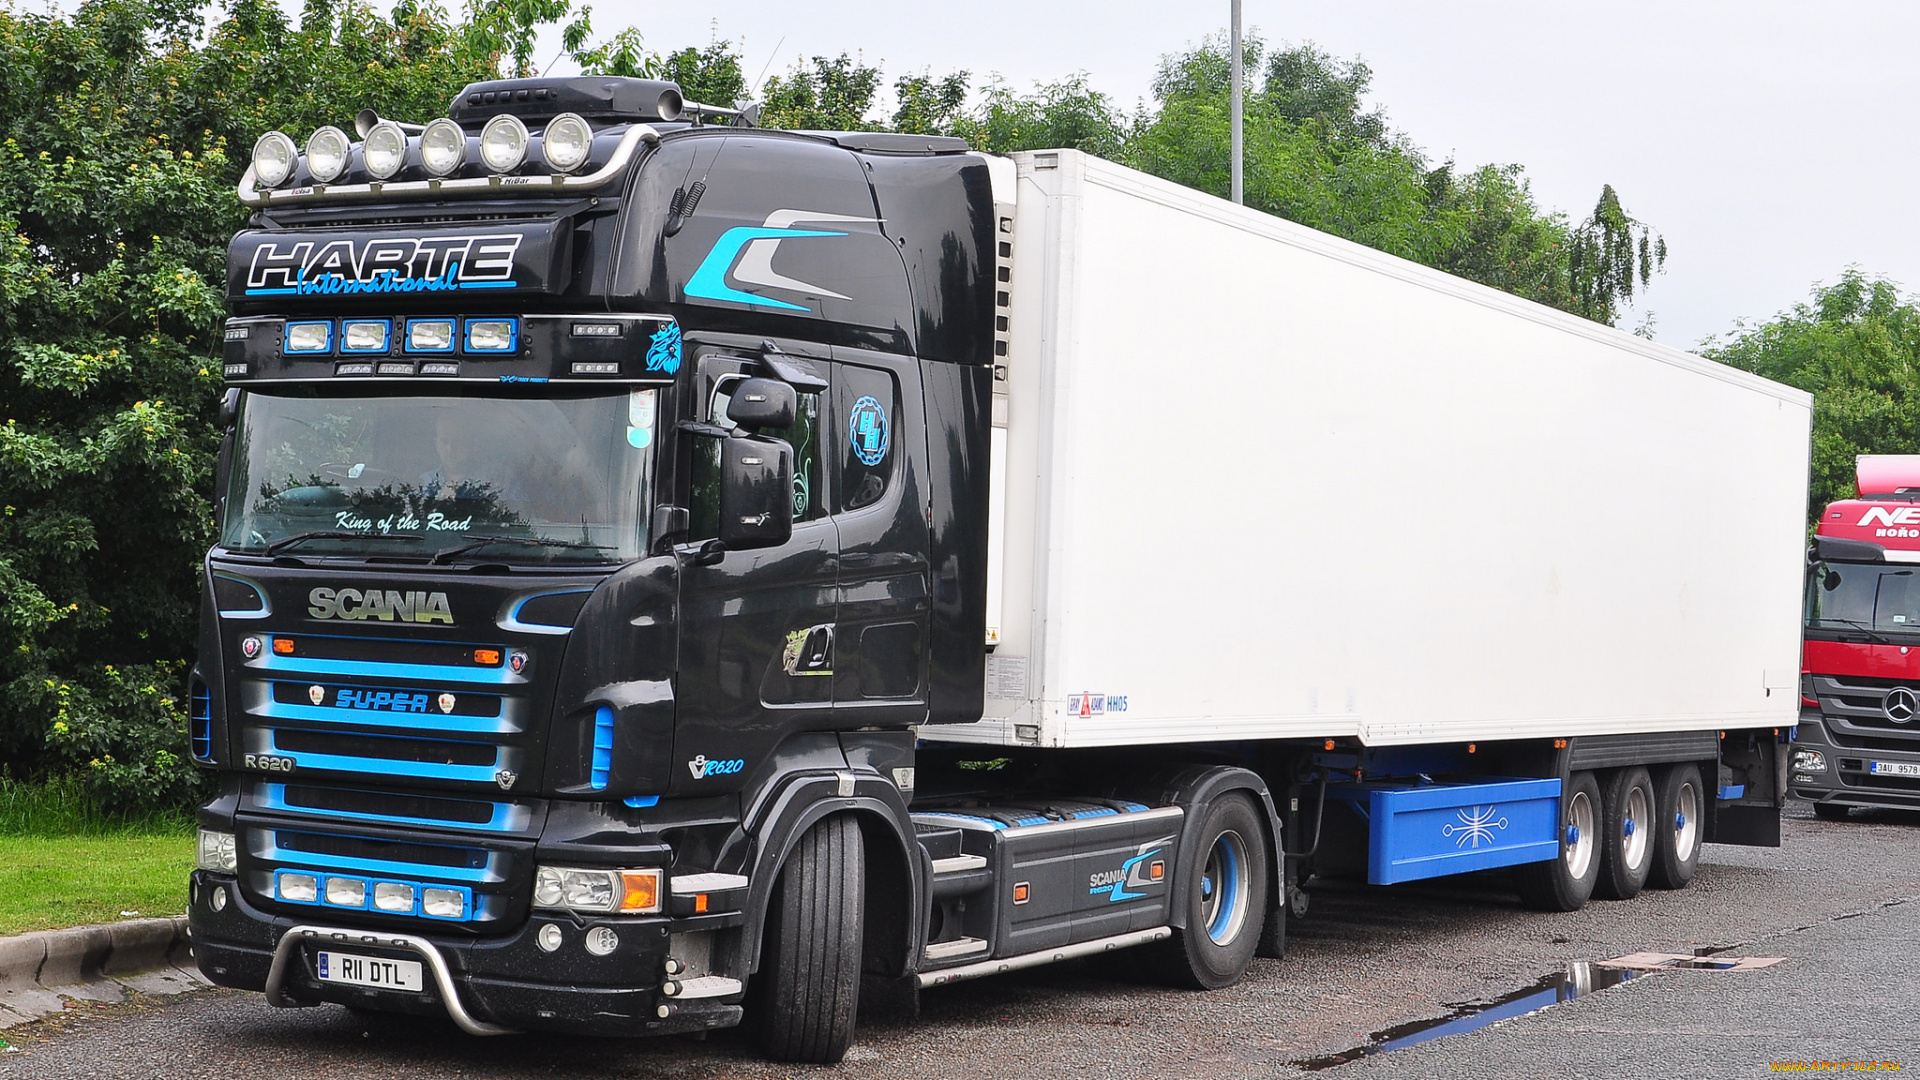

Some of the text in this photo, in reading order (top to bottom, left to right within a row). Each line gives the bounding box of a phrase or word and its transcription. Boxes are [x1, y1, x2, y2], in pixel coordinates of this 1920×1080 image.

[247, 234, 524, 287] HARTE
[297, 261, 458, 295] International
[335, 511, 473, 534] King of the Road
[307, 587, 454, 624] SCANIA
[335, 689, 429, 713] SUPER
[704, 758, 745, 776] R620
[1877, 763, 1893, 772] 3AU
[1089, 869, 1127, 887] SCANIA
[369, 961, 405, 985] DTL
